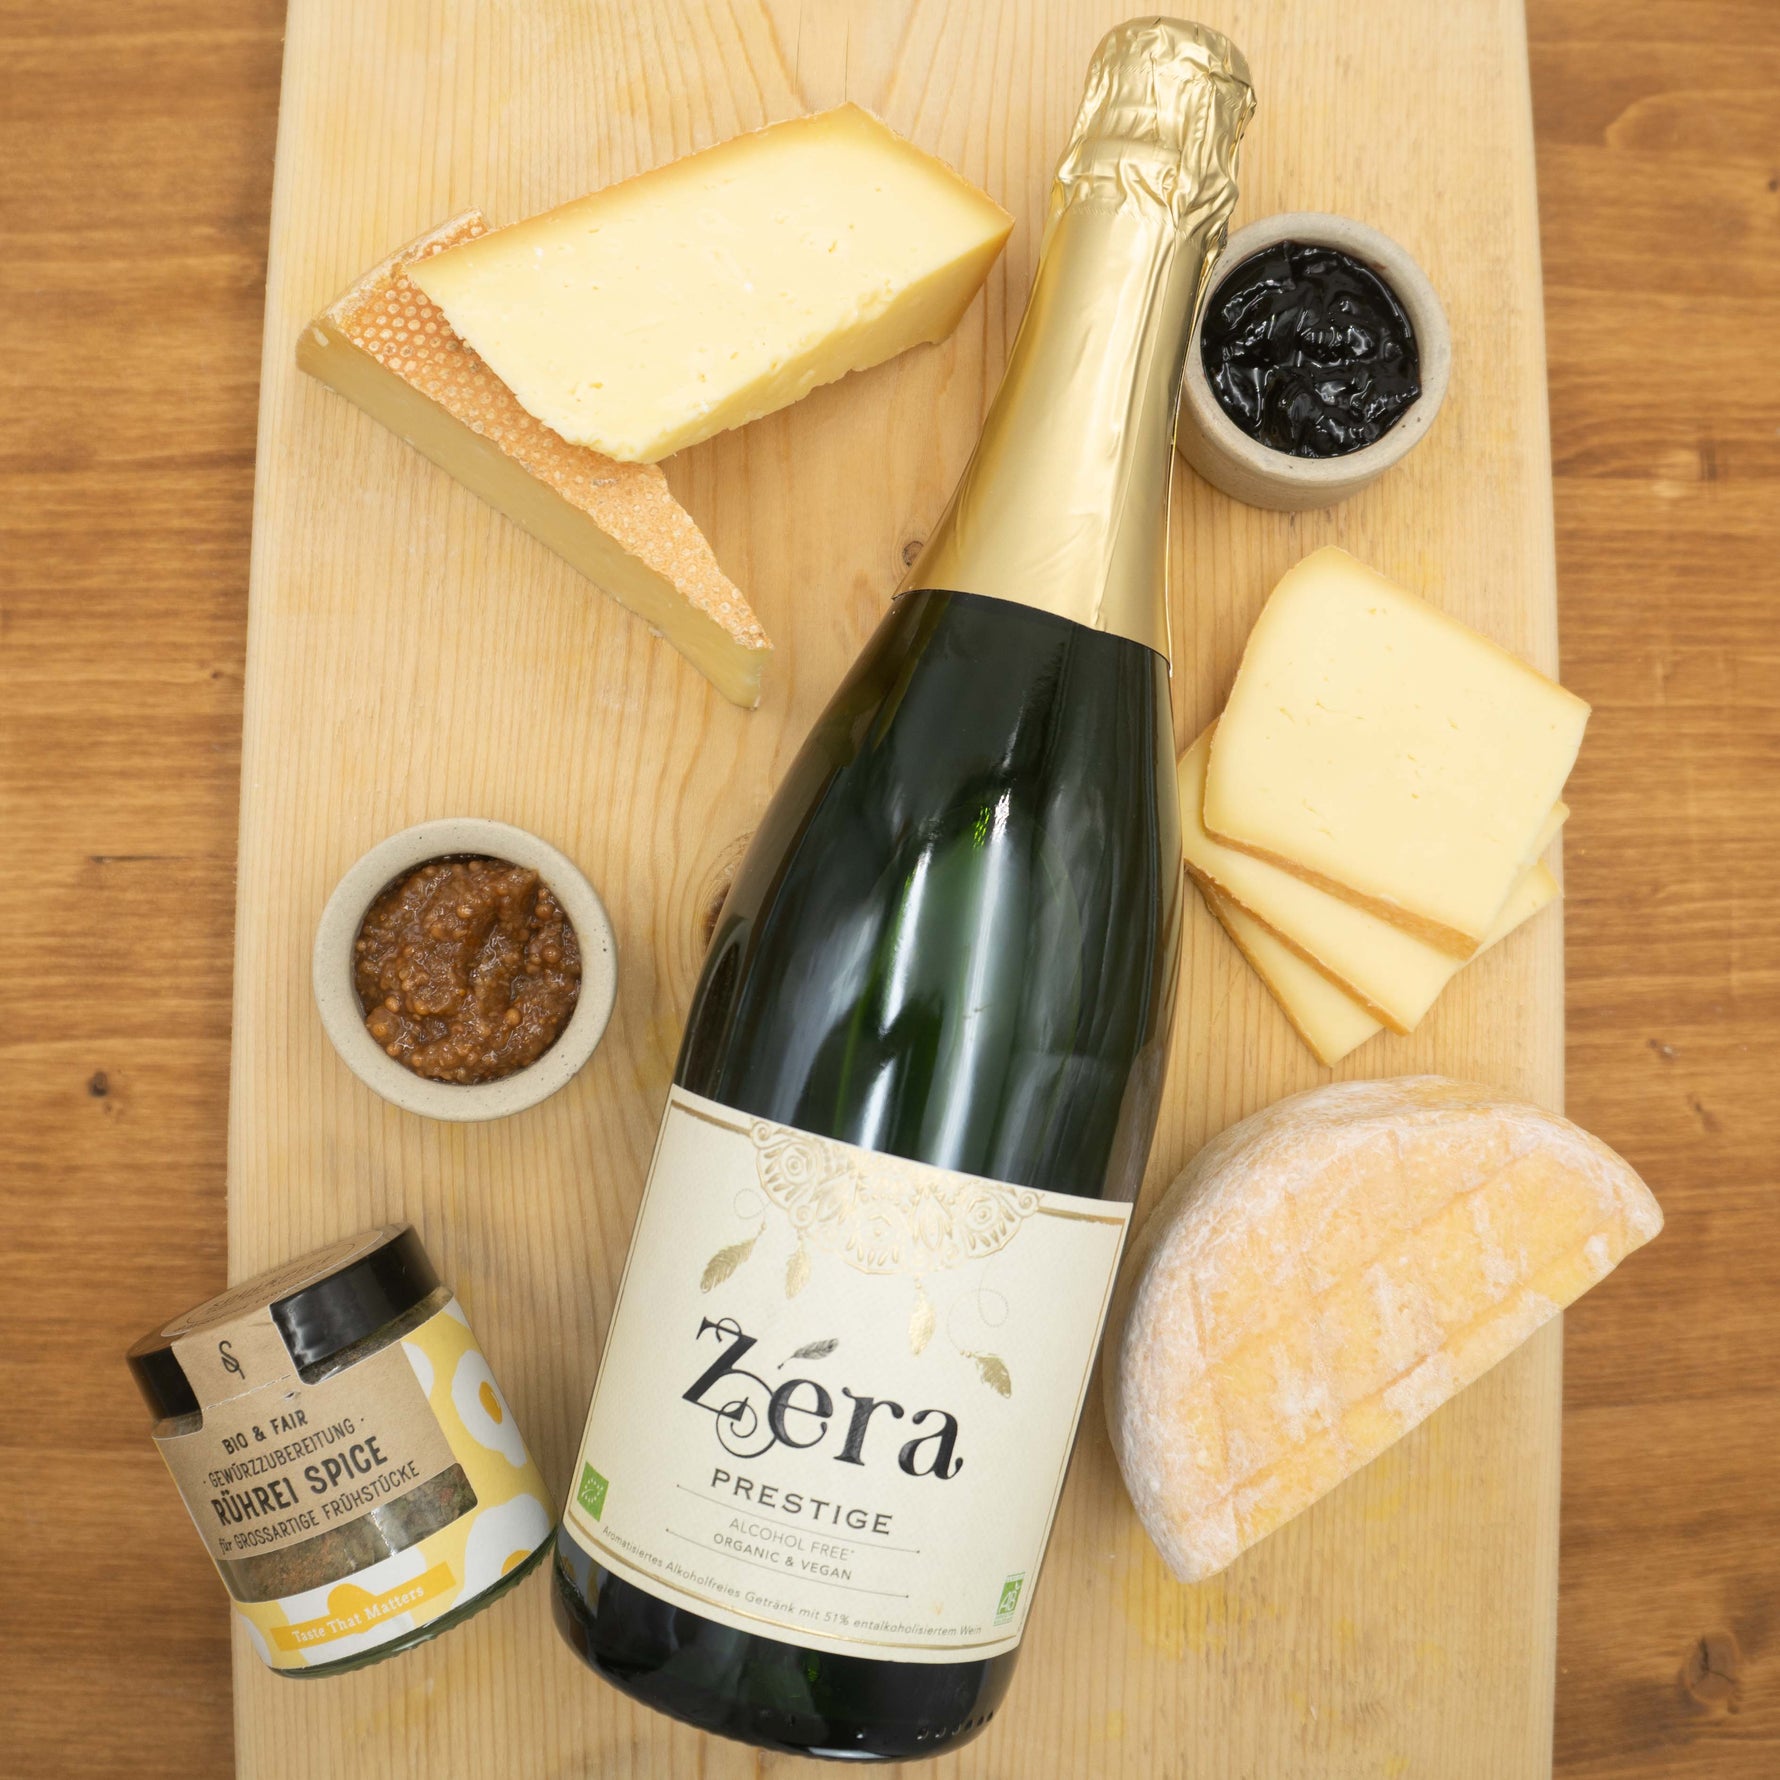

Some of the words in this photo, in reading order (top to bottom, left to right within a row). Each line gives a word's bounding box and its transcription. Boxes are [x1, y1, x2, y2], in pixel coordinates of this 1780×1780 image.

[208, 1418, 356, 1488] GEWÜRZZUBEREITUNG
[221, 1432, 249, 1455] BIO
[252, 1425, 267, 1442] &
[270, 1409, 309, 1435] FAIR
[211, 1477, 299, 1526] RÜHREI
[304, 1436, 389, 1494] SPICE
[219, 1538, 233, 1555] für
[234, 1510, 320, 1550] GROSSARTIGE
[322, 1460, 420, 1520] FRÜHSTÜCKE
[710, 1468, 894, 1535] PRESTIGE
[713, 1533, 780, 1564] ORGANIC
[784, 1556, 794, 1568] &
[801, 1560, 853, 1581] VEGAN
[729, 1518, 804, 1551] ALCOHOL
[292, 1628, 326, 1643] Taste
[327, 1613, 362, 1634] That
[363, 1586, 424, 1620] Matters
[602, 1526, 663, 1568] Aromatisiertes
[665, 1562, 741, 1598] Alkoholfreies
[745, 1591, 795, 1614] Getränk
[799, 1608, 820, 1620] mit
[823, 1612, 850, 1626] 51%
[853, 1619, 957, 1637] entalkoholisiertem
[960, 1626, 982, 1636] Wein
